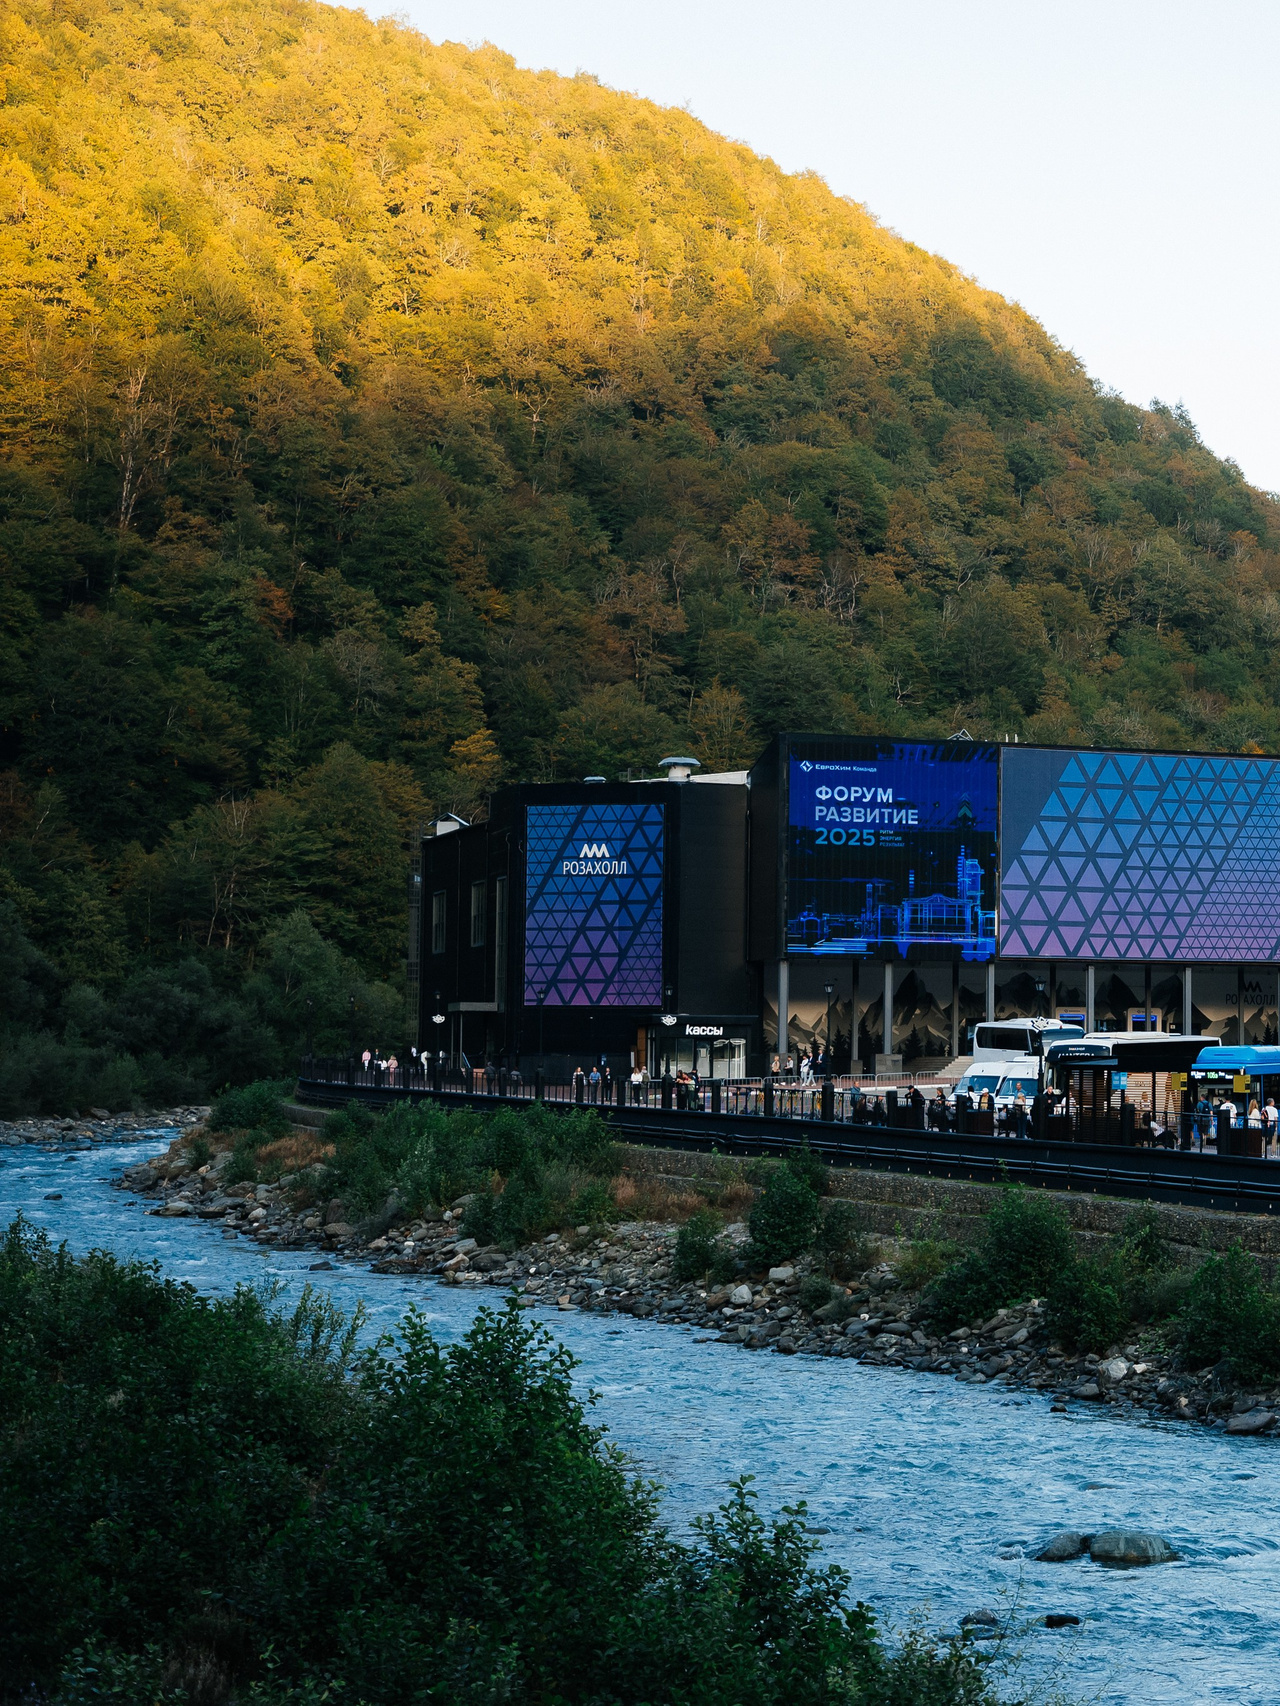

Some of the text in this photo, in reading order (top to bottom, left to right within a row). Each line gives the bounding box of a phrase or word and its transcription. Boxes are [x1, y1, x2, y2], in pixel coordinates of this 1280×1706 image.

[815, 785, 893, 803] ФОРУМ
[815, 806, 919, 824] РАЗВИТИЕ
[815, 827, 876, 846] 2025
[563, 861, 627, 875] РОЗАХОЛЛ
[1225, 993, 1276, 1006] РОАХОЛЛ
[685, 1024, 724, 1036] кассы
